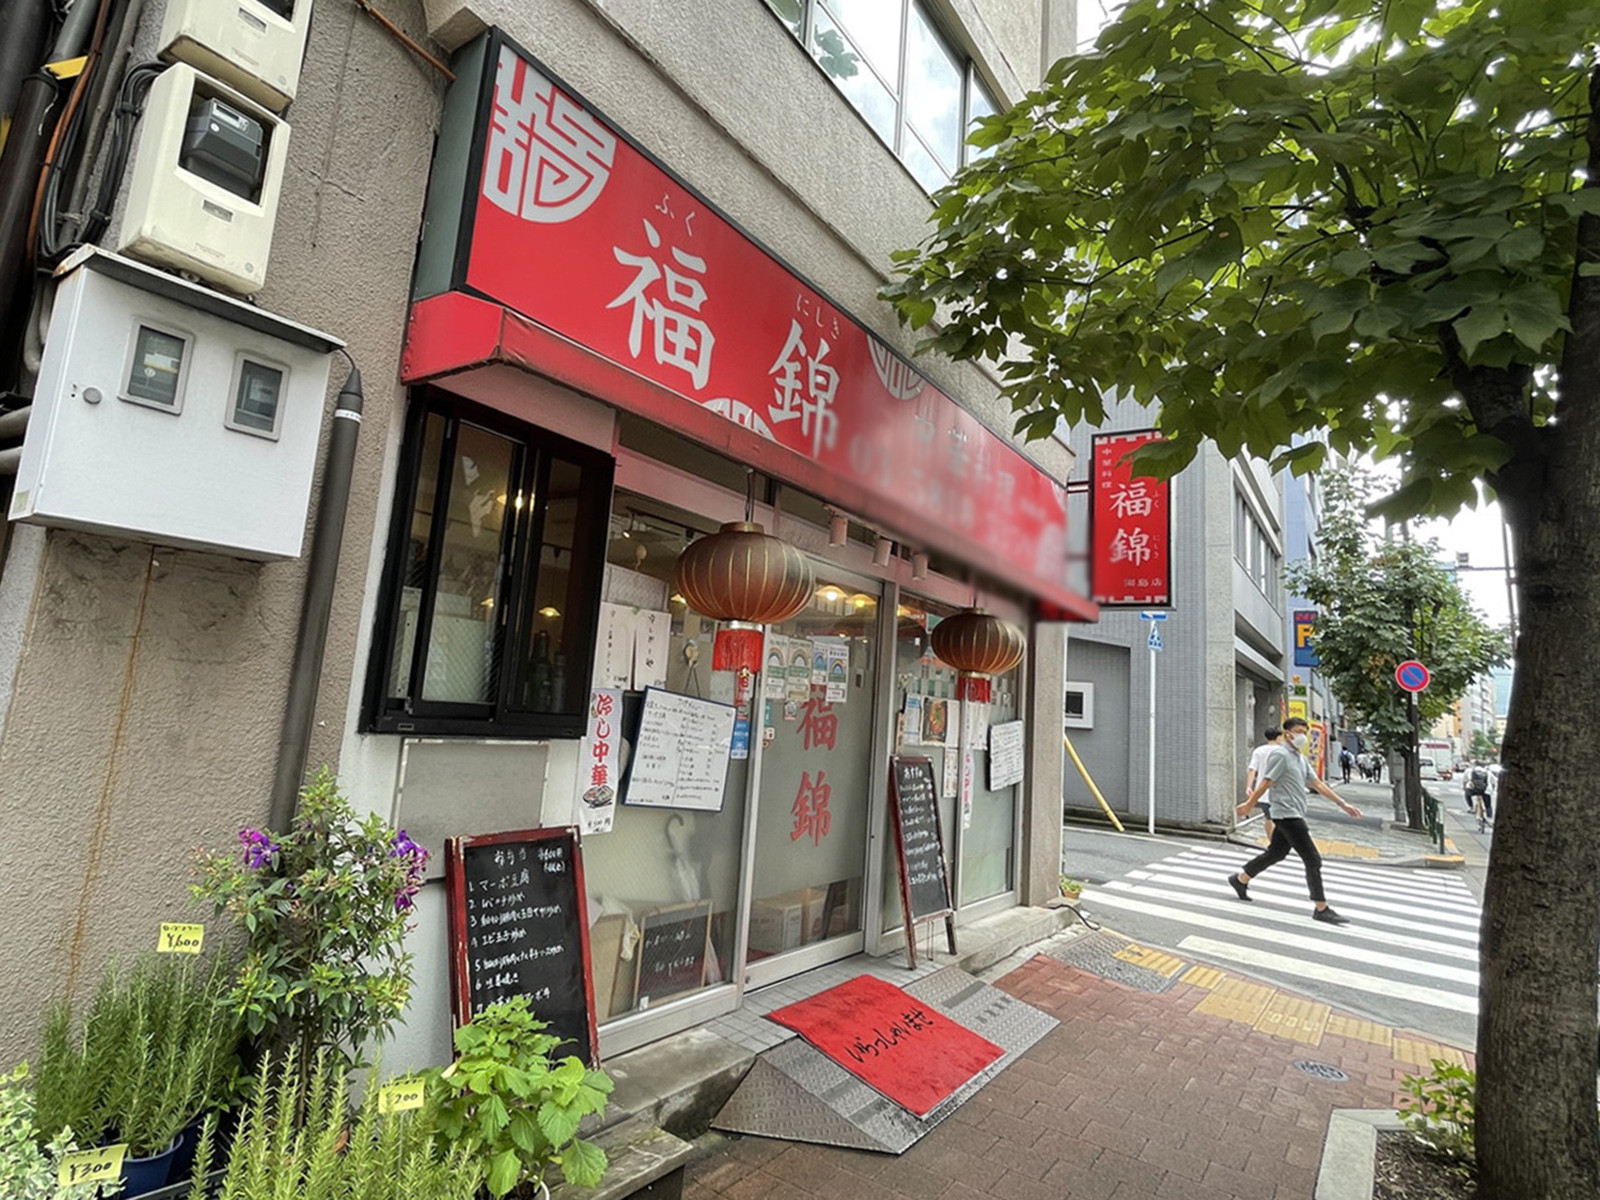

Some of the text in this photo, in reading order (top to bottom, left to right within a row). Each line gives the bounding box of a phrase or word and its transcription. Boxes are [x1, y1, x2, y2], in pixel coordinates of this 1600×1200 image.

[655, 194, 840, 341] ふく にしき
[605, 217, 841, 460] 福錦
[1109, 481, 1152, 567] 福錦
[1297, 623, 1315, 648] P
[591, 693, 613, 786] 冷し中華
[789, 683, 839, 847] 福錦
[167, 932, 200, 949] ¥600
[69, 1161, 113, 1182] ¥300
